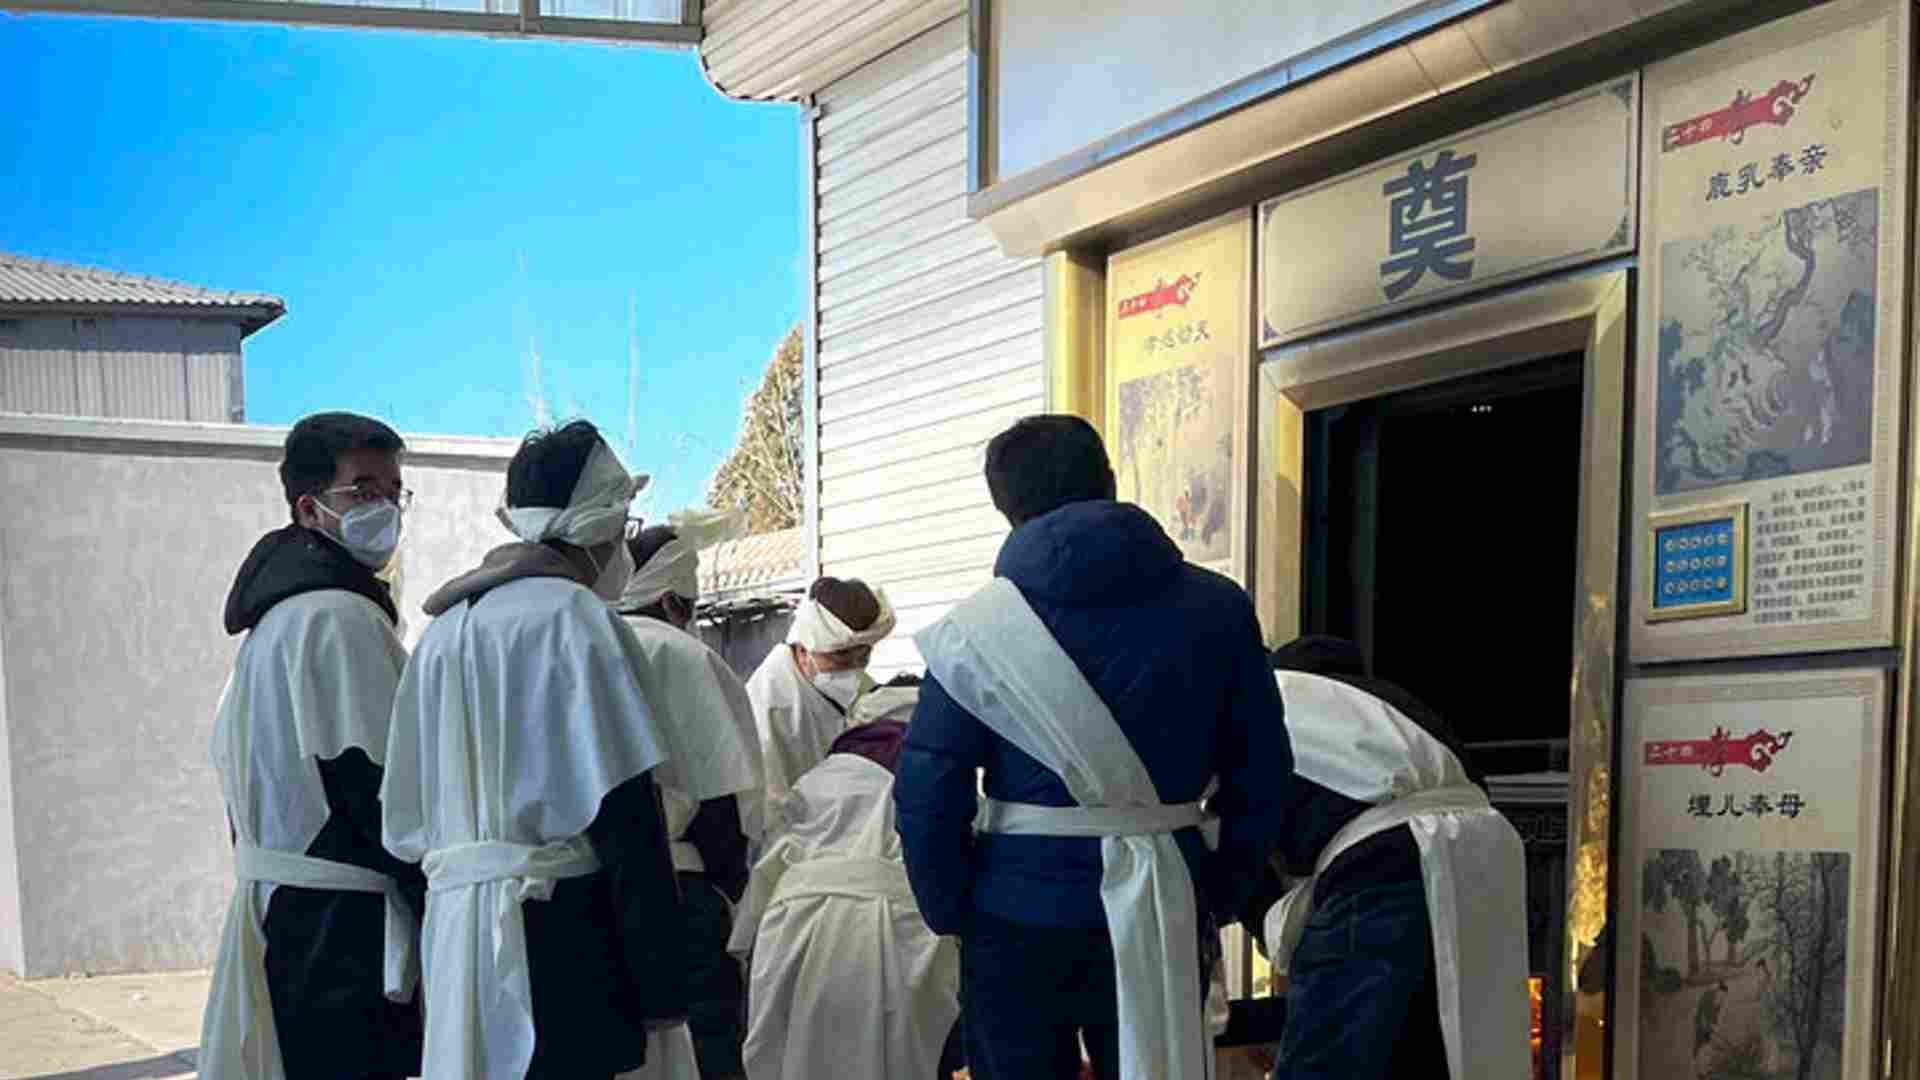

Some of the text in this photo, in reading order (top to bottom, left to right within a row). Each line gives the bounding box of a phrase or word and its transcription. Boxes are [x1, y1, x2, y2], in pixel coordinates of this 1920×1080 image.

[1705, 144, 1828, 201] 鹿乳奉亲
[1380, 150, 1477, 301] 奠
[1687, 793, 1807, 819] 埋儿奉母
